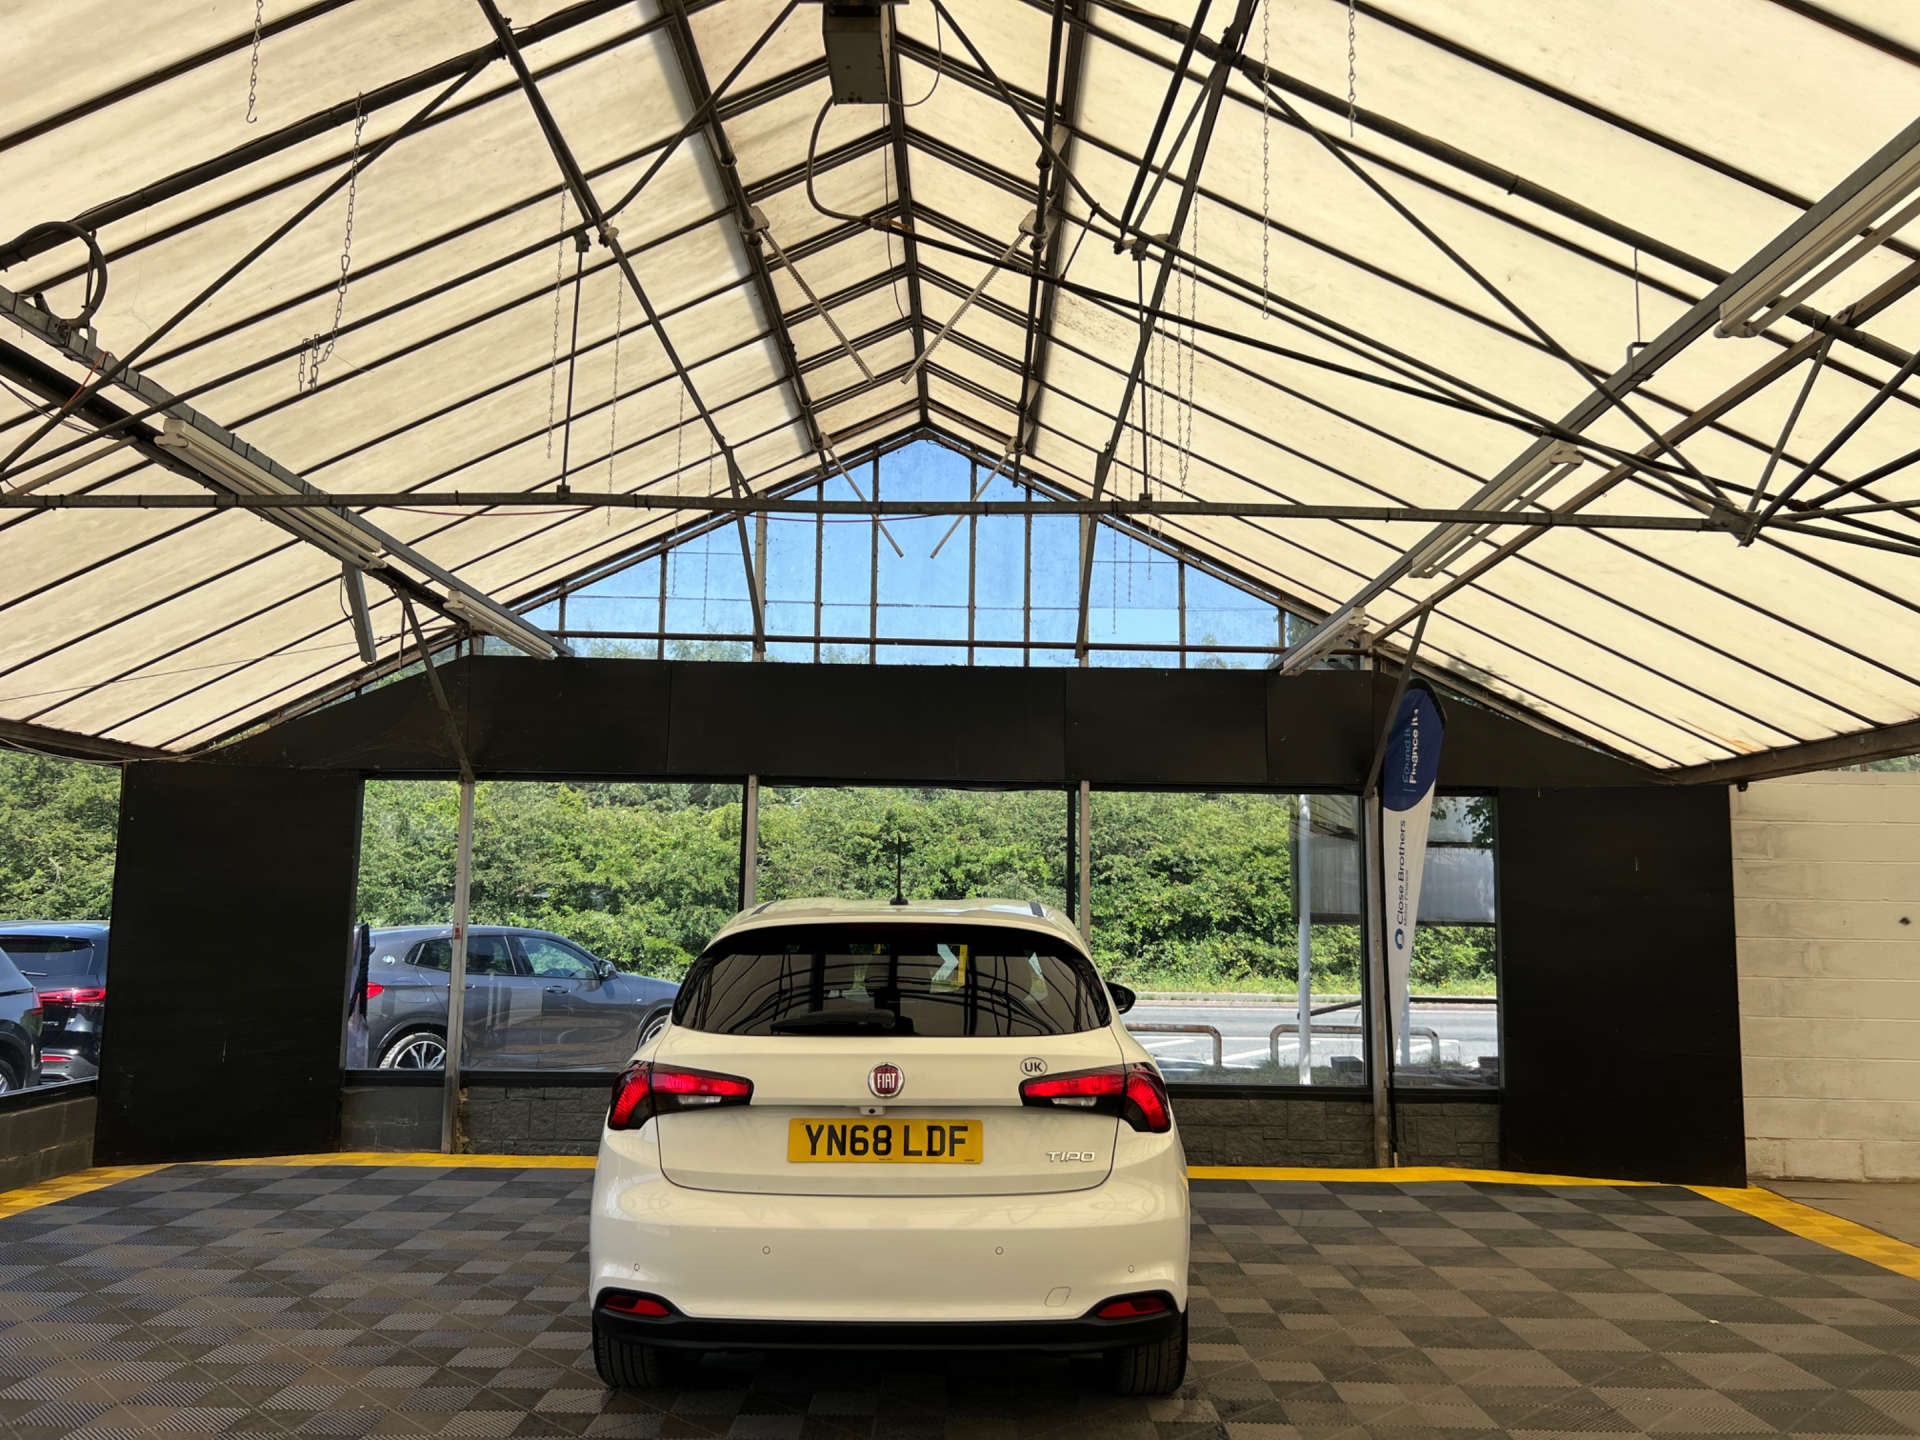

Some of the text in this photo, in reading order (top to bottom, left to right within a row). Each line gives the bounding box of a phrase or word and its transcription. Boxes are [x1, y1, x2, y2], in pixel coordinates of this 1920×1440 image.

[1409, 728, 1419, 785] Finance
[1397, 819, 1406, 925] Close Brothers
[1024, 1062, 1043, 1073] UK
[877, 1073, 897, 1089] FIAT
[805, 1124, 969, 1157] YN68 LDF
[1047, 1151, 1096, 1162] TIPO
